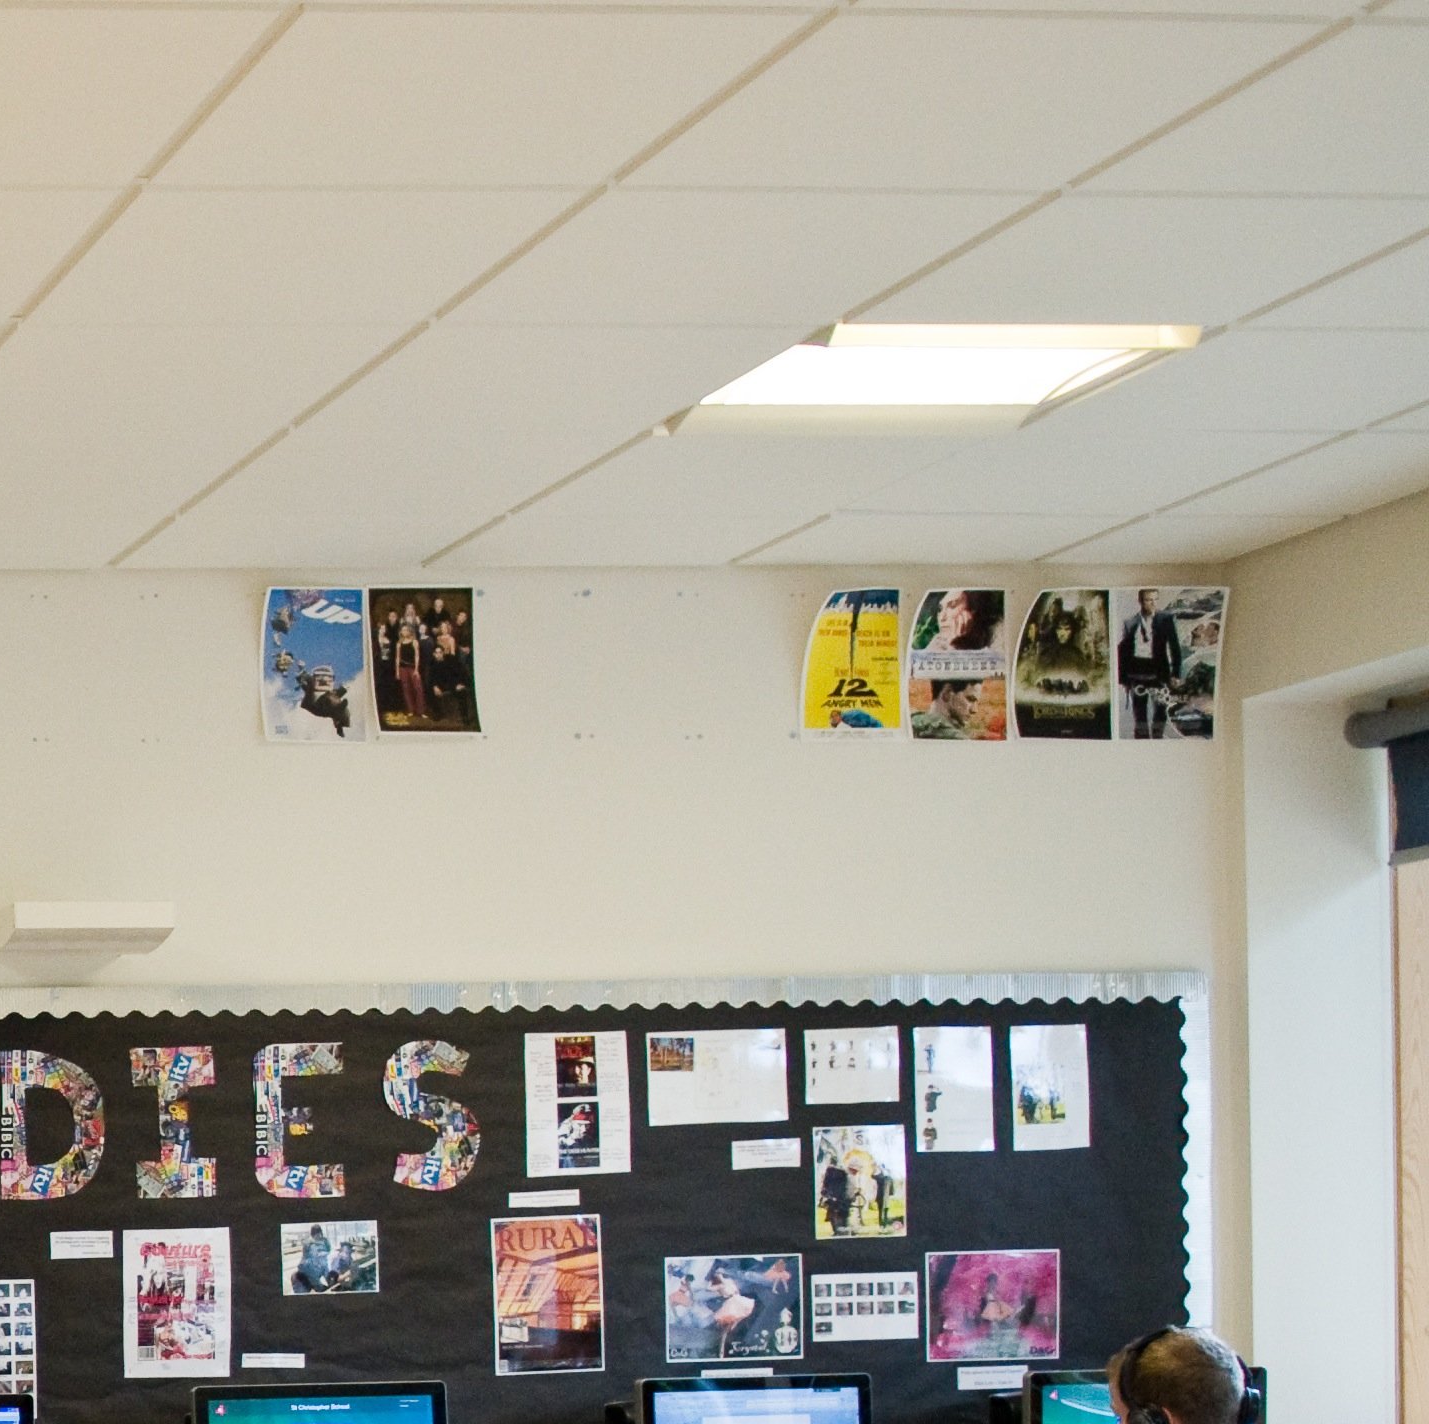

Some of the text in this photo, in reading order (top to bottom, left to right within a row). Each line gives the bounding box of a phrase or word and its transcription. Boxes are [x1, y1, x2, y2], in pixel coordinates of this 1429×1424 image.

[827, 679, 878, 699] 12
[821, 700, 856, 708] ANGRY
[169, 1055, 190, 1081] itv
[0, 1117, 14, 1160] BBC
[255, 1114, 268, 1157] BBC
[32, 1167, 52, 1194] itv
[422, 1158, 441, 1184] itv
[298, 1404, 329, 1412] Christopher
